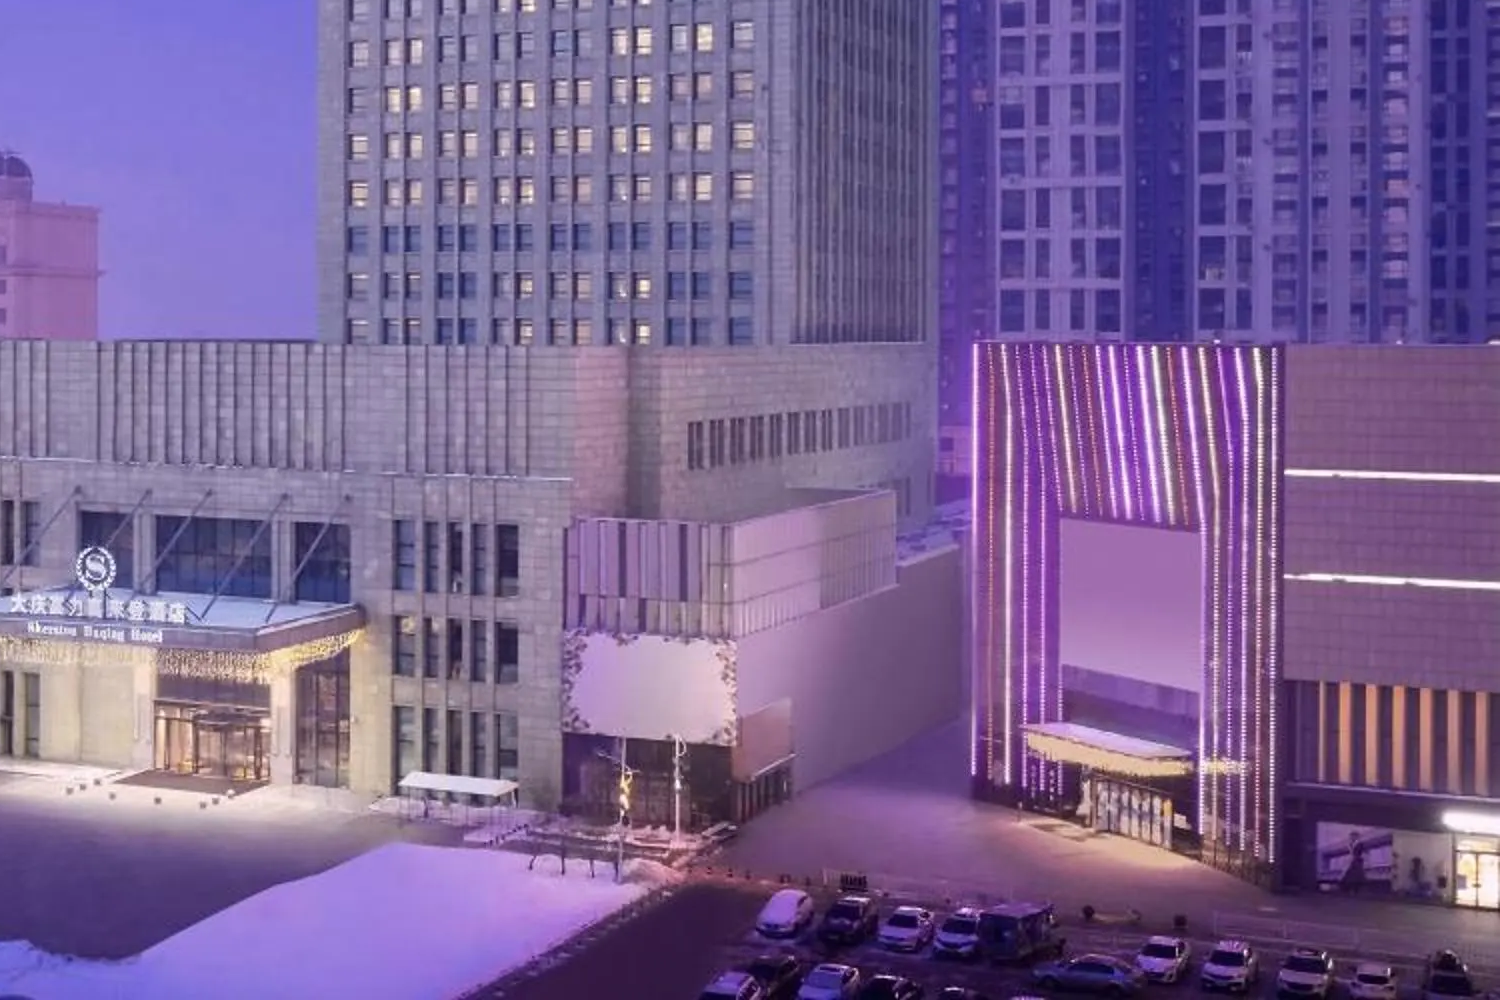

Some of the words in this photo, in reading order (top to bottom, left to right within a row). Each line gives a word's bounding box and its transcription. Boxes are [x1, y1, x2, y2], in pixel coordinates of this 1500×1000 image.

[10, 592, 185, 623] 大庆富力来登酒店
[131, 627, 163, 643] Hotel
